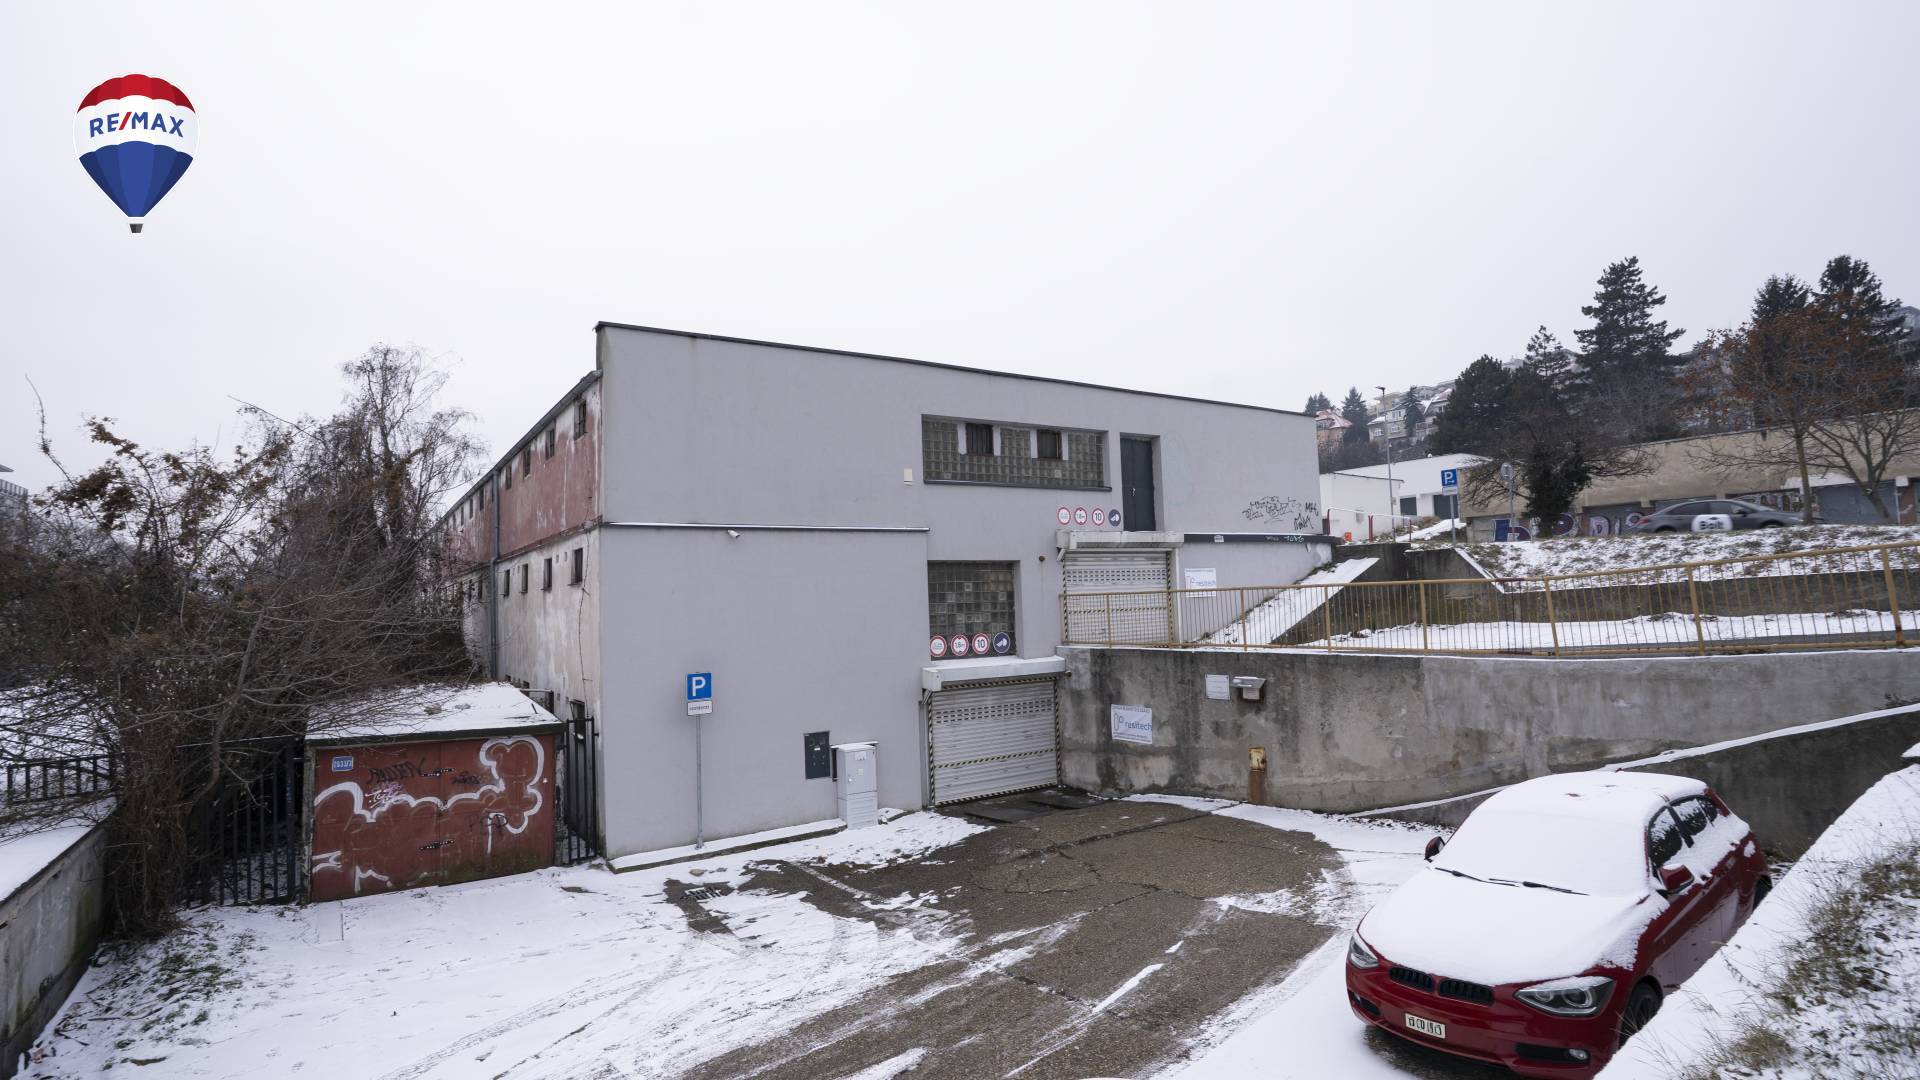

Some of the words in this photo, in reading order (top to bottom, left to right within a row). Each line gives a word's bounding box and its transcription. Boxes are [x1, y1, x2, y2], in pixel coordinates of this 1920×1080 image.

[1094, 512, 1102, 521] 10
[976, 639, 986, 649] 10
[692, 676, 706, 697] P
